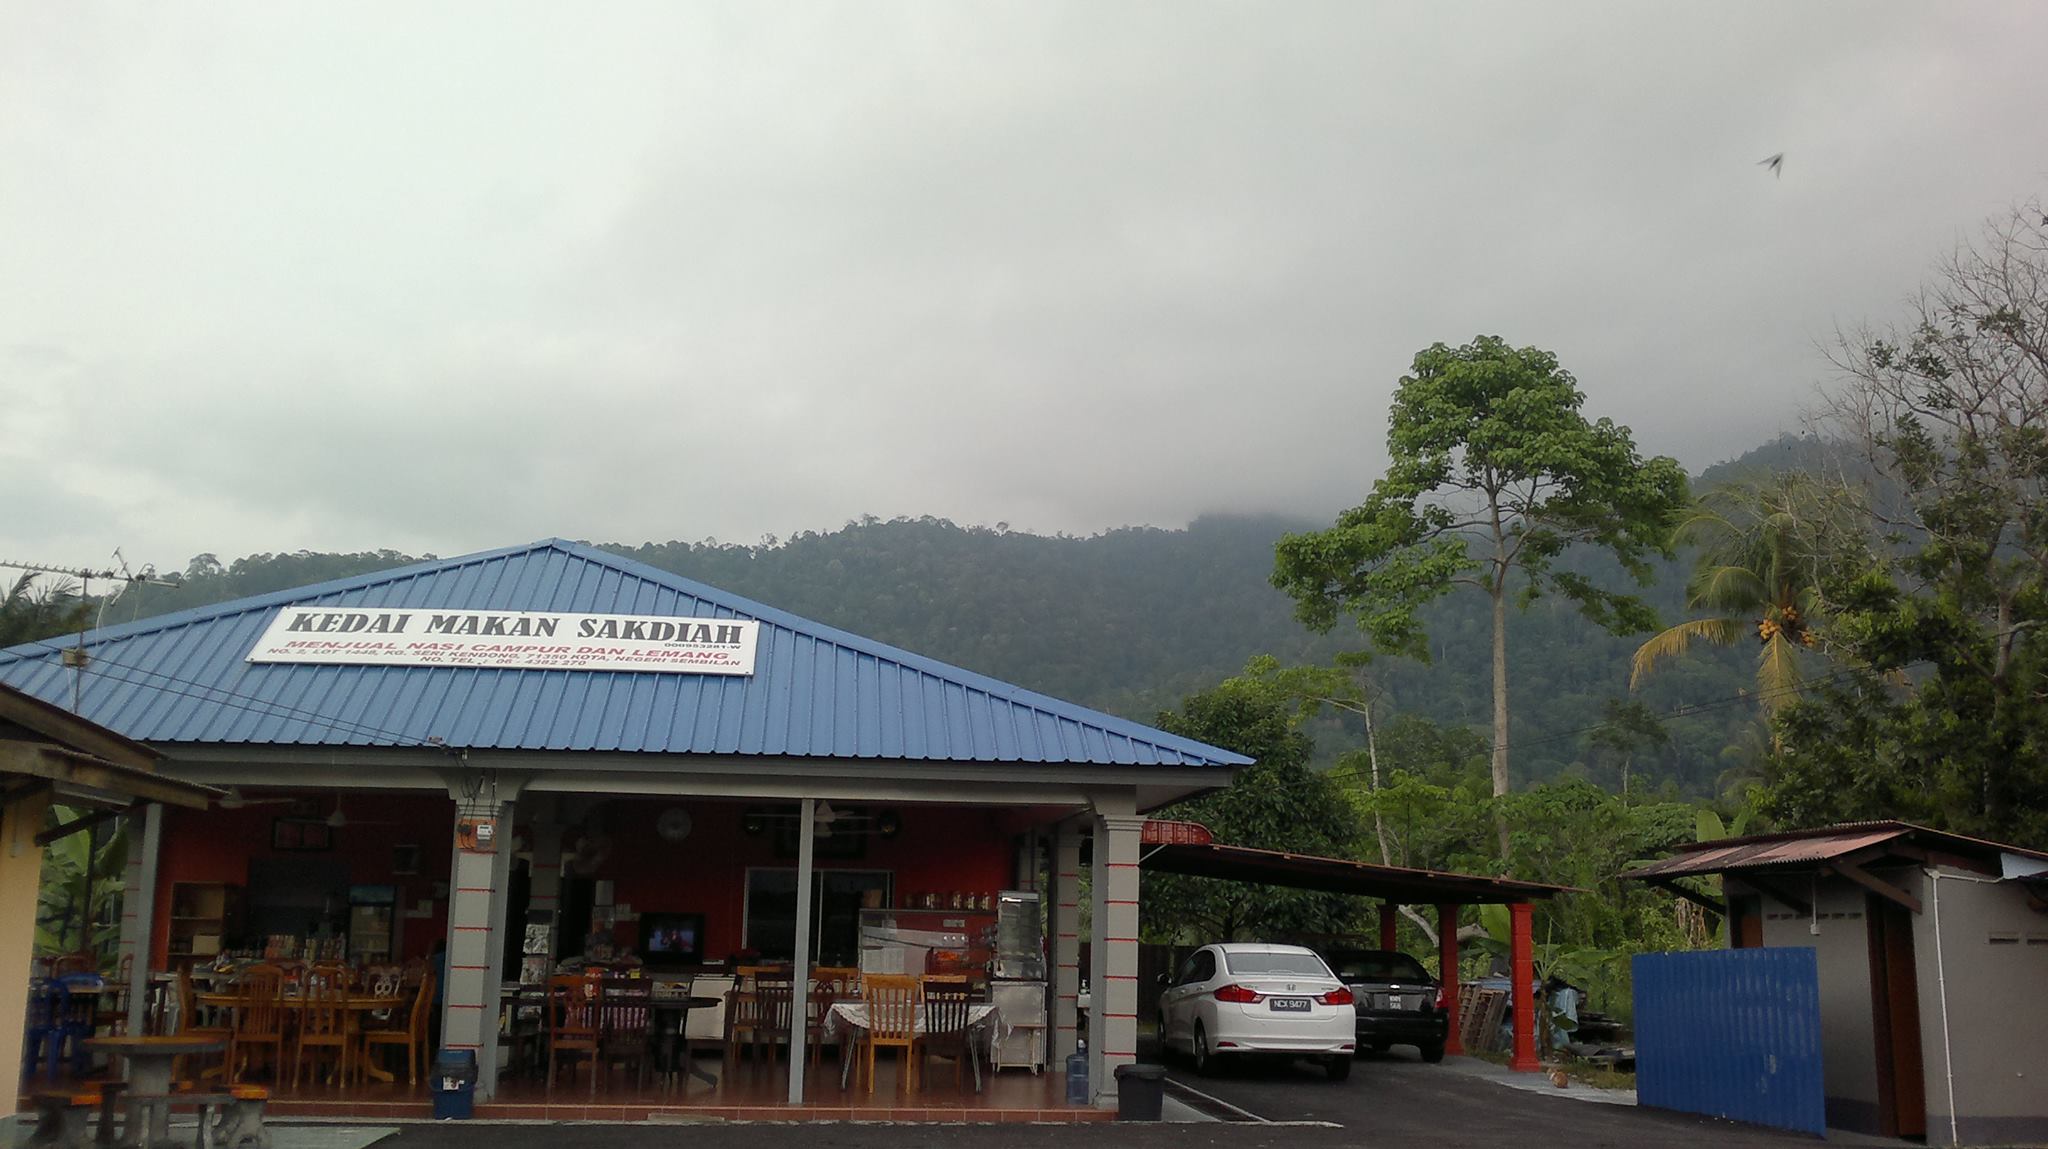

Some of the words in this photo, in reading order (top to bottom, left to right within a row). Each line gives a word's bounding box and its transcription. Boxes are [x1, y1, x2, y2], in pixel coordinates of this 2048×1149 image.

[286, 613, 412, 633] KEDAI
[424, 615, 560, 637] MAKAN
[577, 618, 744, 644] SAKDIAH
[285, 641, 397, 650] MENJUAL
[406, 642, 465, 651] NASI
[471, 644, 571, 654] CAMPUR
[582, 647, 624, 655] DAN
[632, 649, 729, 660] LEMANG
[570, 654, 610, 662] KOTA,
[670, 657, 742, 667] SEMBILAN
